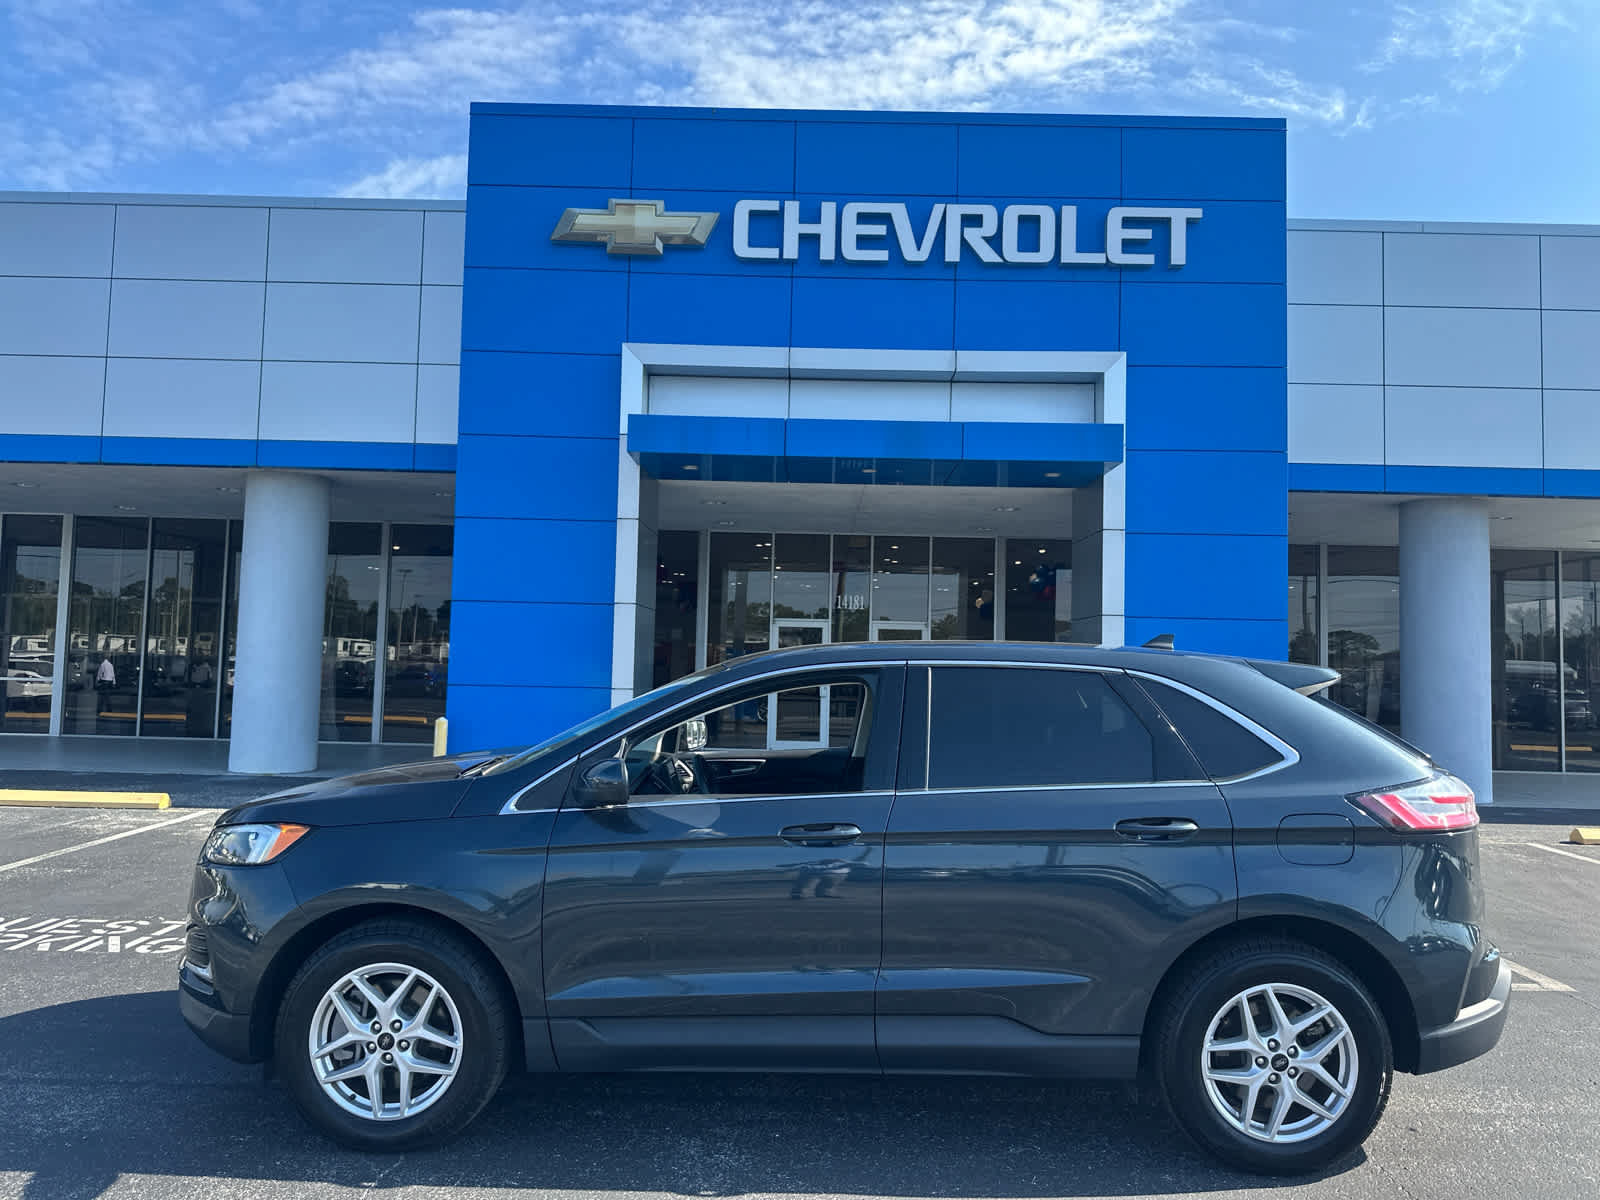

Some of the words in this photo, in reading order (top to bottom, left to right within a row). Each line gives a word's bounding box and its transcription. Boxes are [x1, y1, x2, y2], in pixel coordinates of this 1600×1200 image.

[733, 199, 1203, 267] CHEVROLET
[837, 594, 865, 610] 14181
[0, 917, 187, 936] UEST
